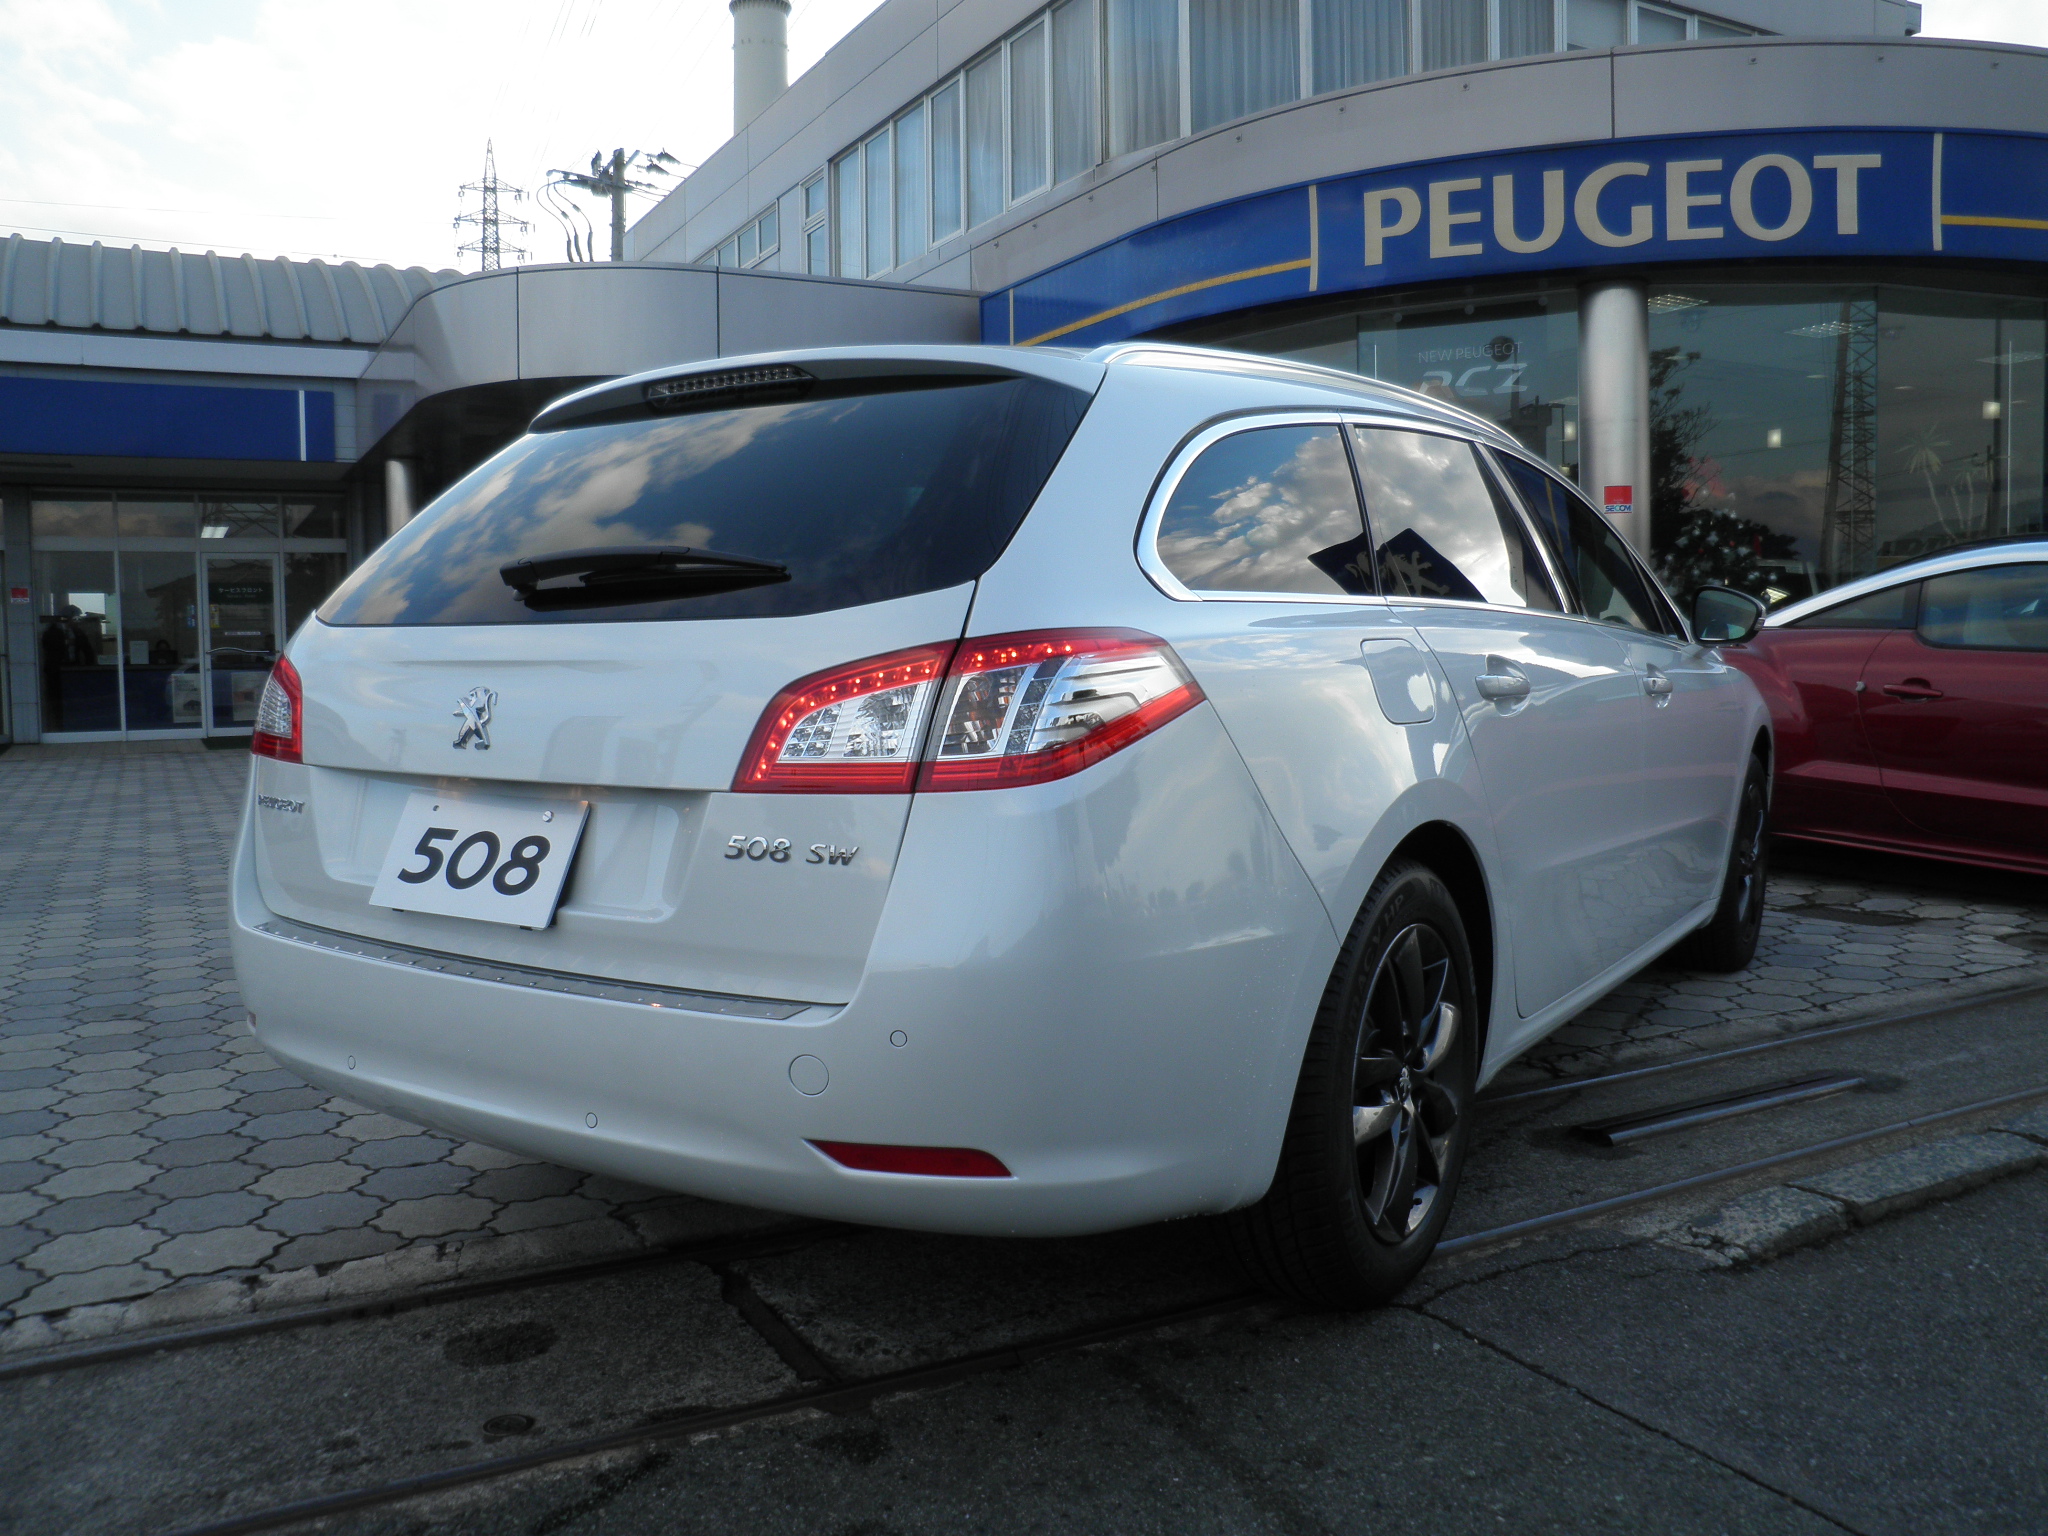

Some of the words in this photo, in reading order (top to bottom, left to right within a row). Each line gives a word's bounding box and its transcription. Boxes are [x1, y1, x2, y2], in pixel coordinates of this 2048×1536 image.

[1363, 153, 1882, 267] PEUGEOT
[1418, 349, 1453, 364] NEW
[1455, 341, 1524, 361] PEUGEOT
[1417, 362, 1529, 399] RCZ
[1605, 504, 1633, 512] SECOM
[397, 827, 551, 896] 508
[723, 835, 792, 864] 508
[805, 842, 860, 866] SW
[1384, 893, 1405, 927] HP
